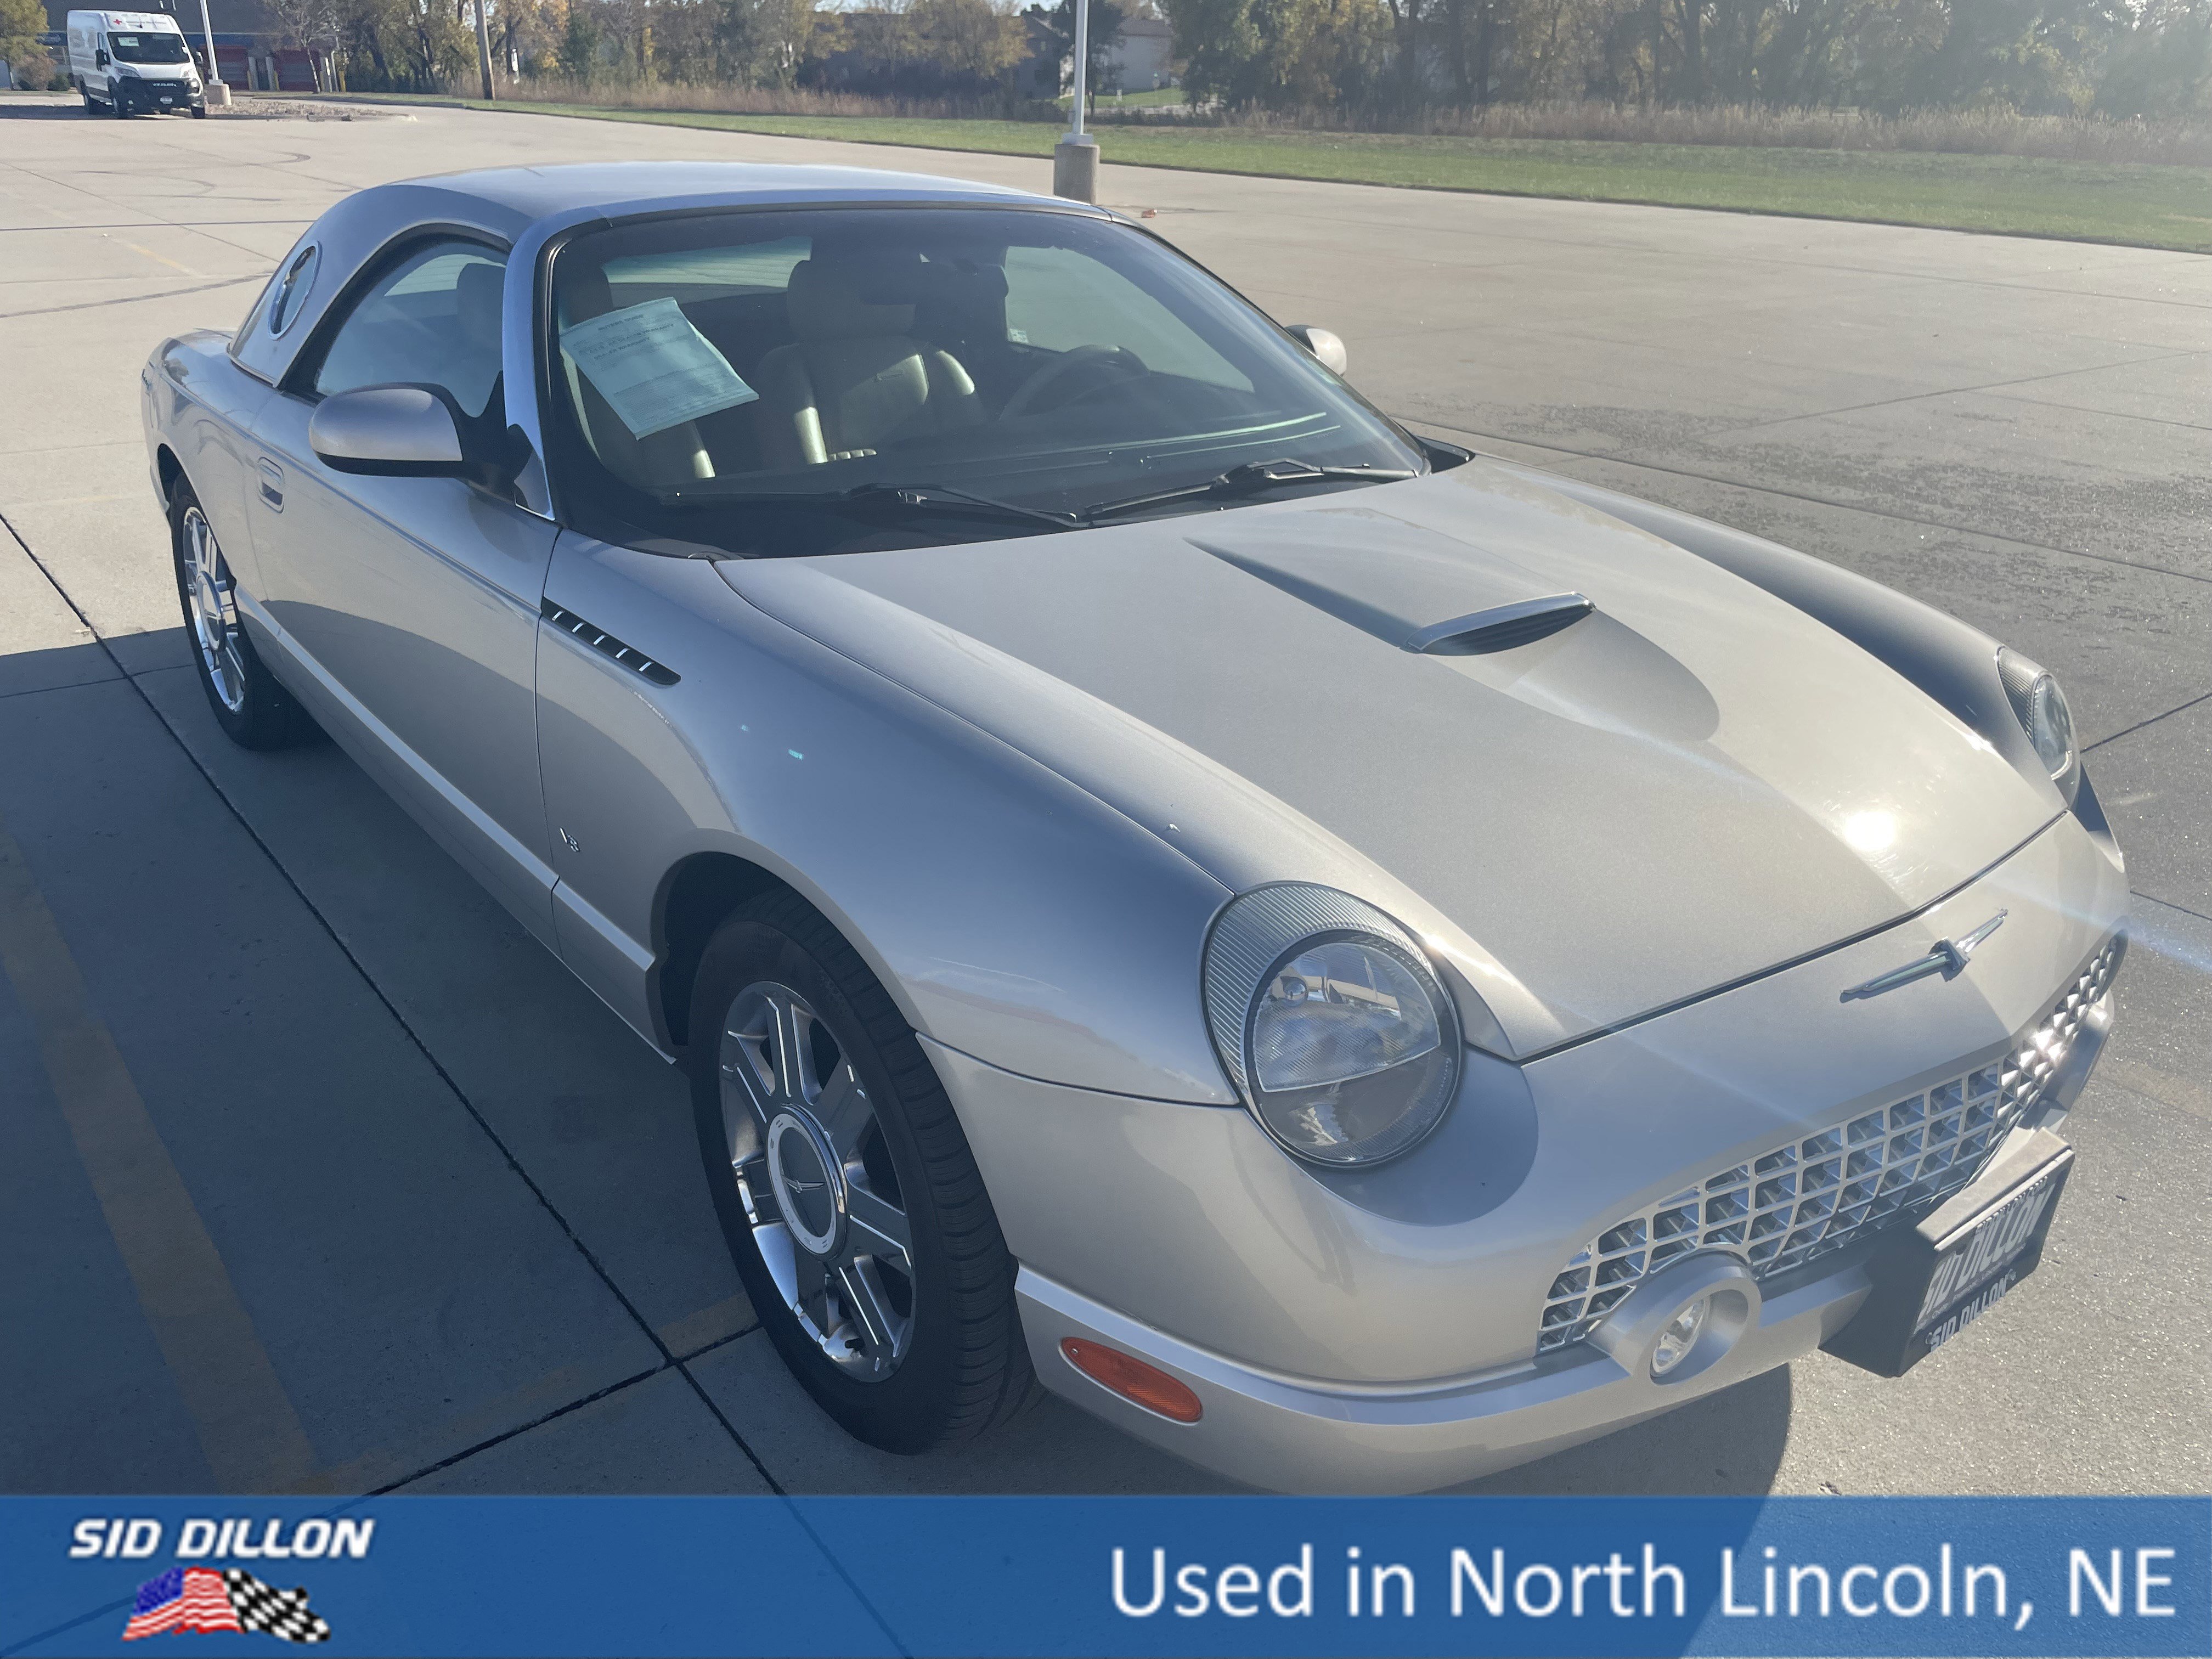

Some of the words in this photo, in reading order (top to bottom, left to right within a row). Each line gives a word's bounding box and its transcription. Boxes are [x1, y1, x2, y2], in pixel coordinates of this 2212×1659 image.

[1916, 1254, 1964, 1325] SID
[1954, 1183, 2056, 1292] DILLON
[1930, 1316, 1957, 1353] SID
[1959, 1273, 2009, 1333] DILLON
